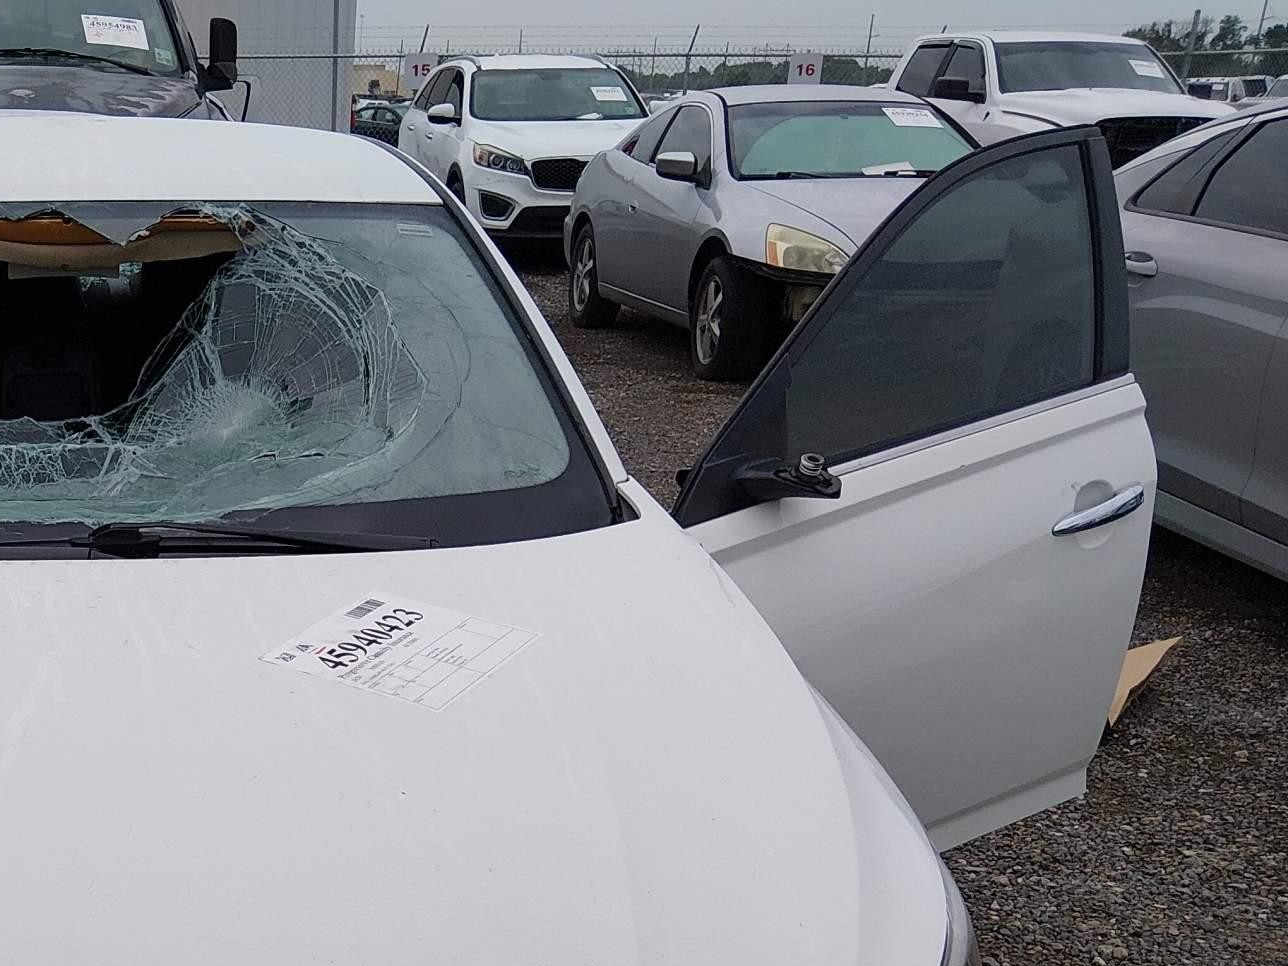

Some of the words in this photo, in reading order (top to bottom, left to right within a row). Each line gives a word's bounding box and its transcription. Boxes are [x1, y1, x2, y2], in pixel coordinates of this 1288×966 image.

[411, 63, 431, 77] 15
[796, 63, 816, 77] 16
[317, 608, 424, 669] 45940423
